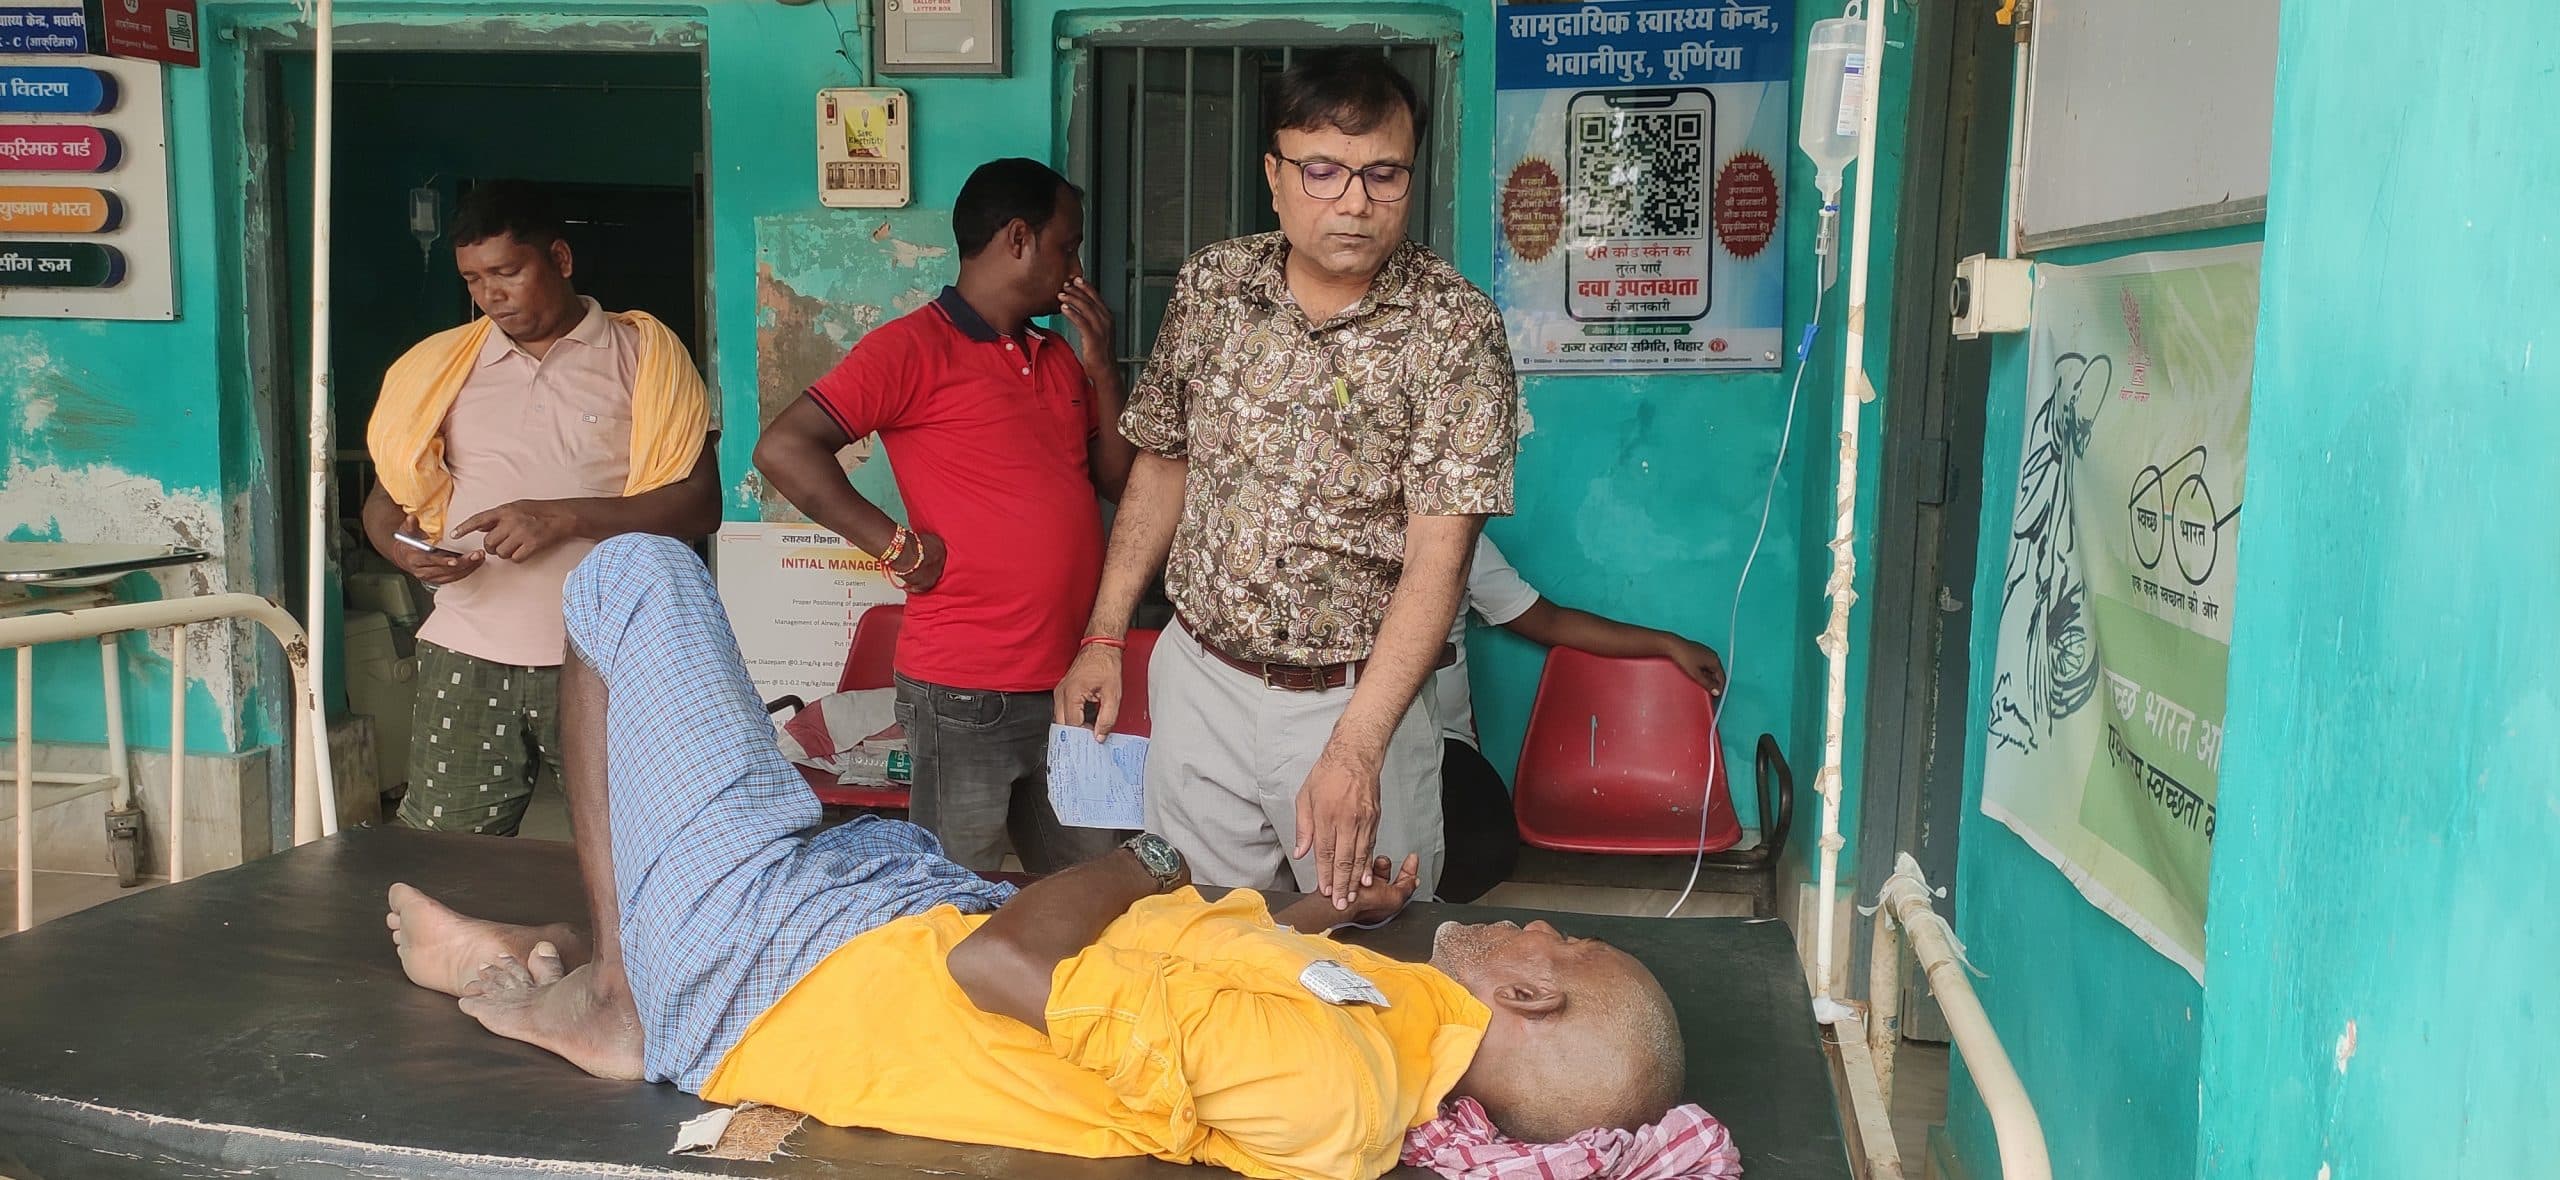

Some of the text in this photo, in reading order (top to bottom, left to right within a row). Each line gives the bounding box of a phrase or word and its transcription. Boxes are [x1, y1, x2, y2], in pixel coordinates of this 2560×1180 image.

[1509, 0, 1779, 45] सामुदायिक स्वास्थ्य केन्द्र,
[13, 36, 22, 47] C
[1546, 40, 1743, 82] भवानीपुर, पूर्णिया
[11, 78, 69, 97] वितरण
[62, 137, 91, 156] वार्ड
[52, 201, 91, 216] भारत
[1612, 243, 1639, 257] कोड
[1672, 246, 1692, 257] कर
[37, 258, 73, 272] रूम
[1616, 262, 1637, 278] तुरंत
[1577, 278, 1700, 297] दवा उपलब्धता
[1605, 298, 1671, 312] की जानकारी
[1561, 339, 1705, 353] राज्य स्वास्थ्य समिति, बिहार
[2137, 507, 2206, 547] स्वच्छ भारत
[782, 533, 841, 544] स्वास्थ्य विभाग
[781, 558, 884, 571] INITIAL MANAGE
[846, 579, 866, 587] patient
[813, 599, 843, 607] Positioning
[2131, 574, 2219, 622] एक कदम स्वच्छता की ओर
[775, 618, 812, 626] Management
[2145, 690, 2197, 753] भारत
[2147, 763, 2204, 832] स्वच्छता
